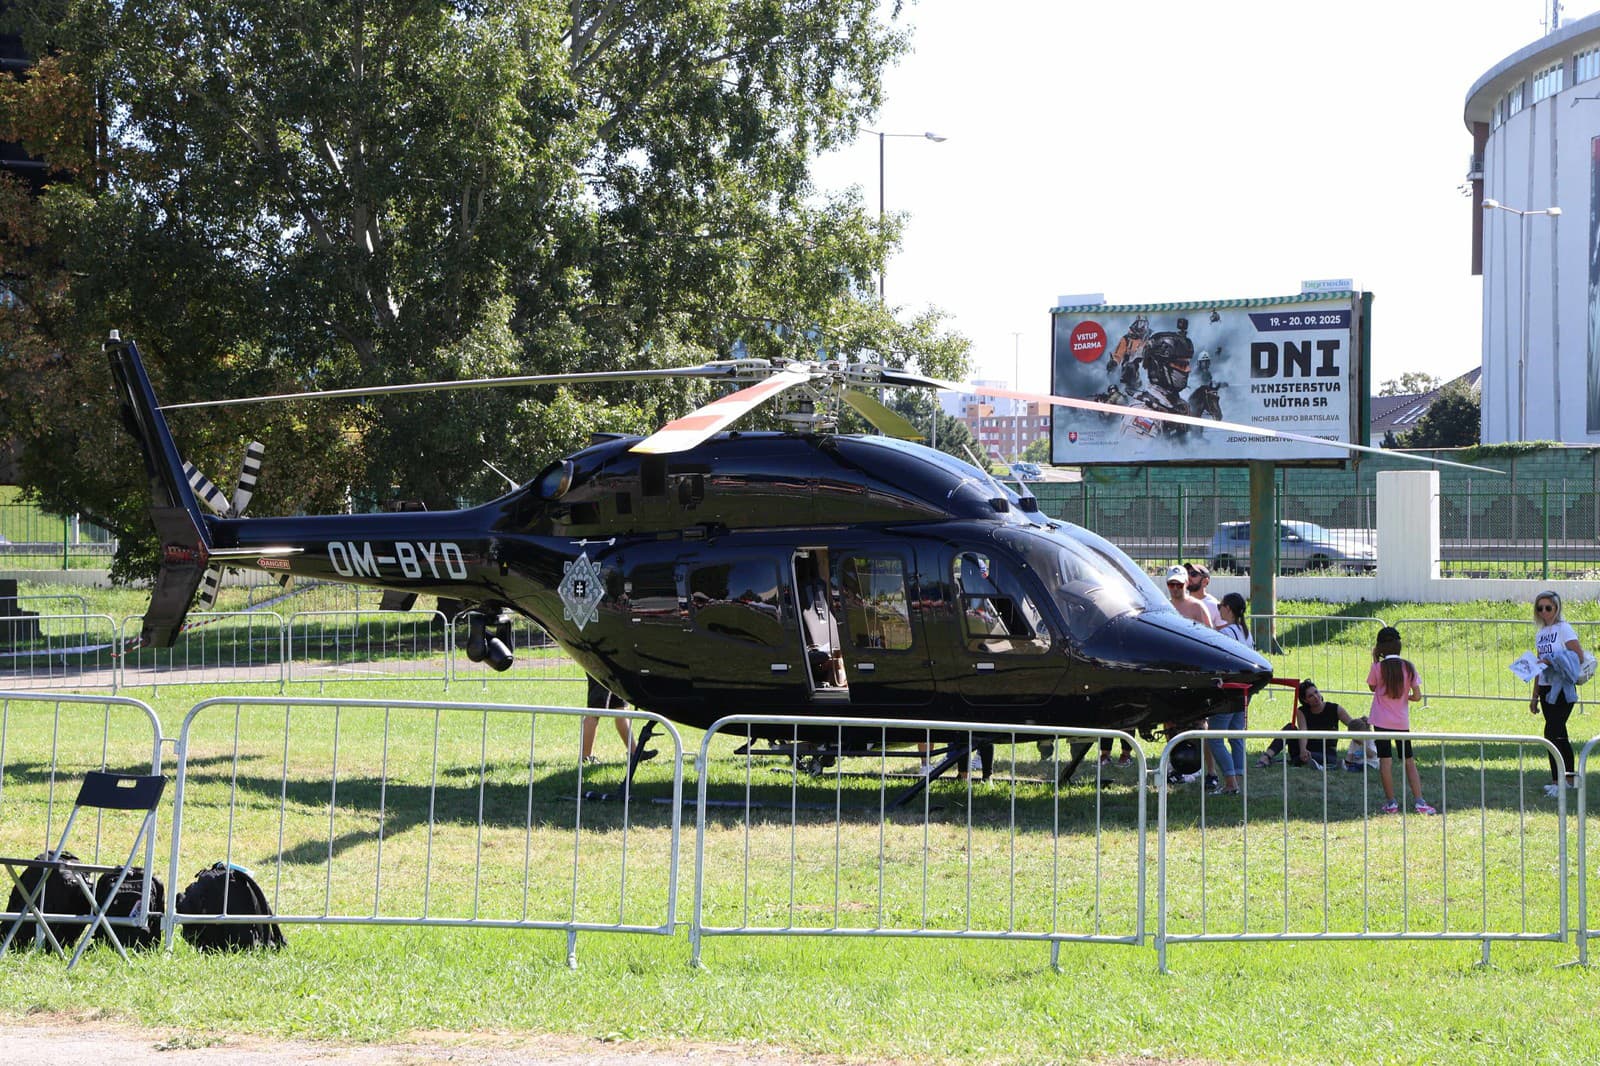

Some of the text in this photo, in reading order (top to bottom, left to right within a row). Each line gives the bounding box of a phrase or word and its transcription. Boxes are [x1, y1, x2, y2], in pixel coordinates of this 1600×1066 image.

[1270, 317, 1280, 326] 19.
[1289, 317, 1302, 326] 20.
[1304, 316, 1317, 325] 09.
[1319, 315, 1341, 324] 2025
[1076, 332, 1097, 340] VSTUP
[1074, 342, 1102, 350] ZDARMA
[1251, 340, 1340, 378] DNI
[1251, 382, 1341, 393] MINISTERSTVA
[1263, 395, 1328, 408] VNÚTRA SR
[1251, 415, 1280, 423] INCHEBA
[1300, 414, 1340, 422] BRATISLAVA
[260, 560, 289, 568] DANGER
[327, 541, 468, 580] OM-BYD
